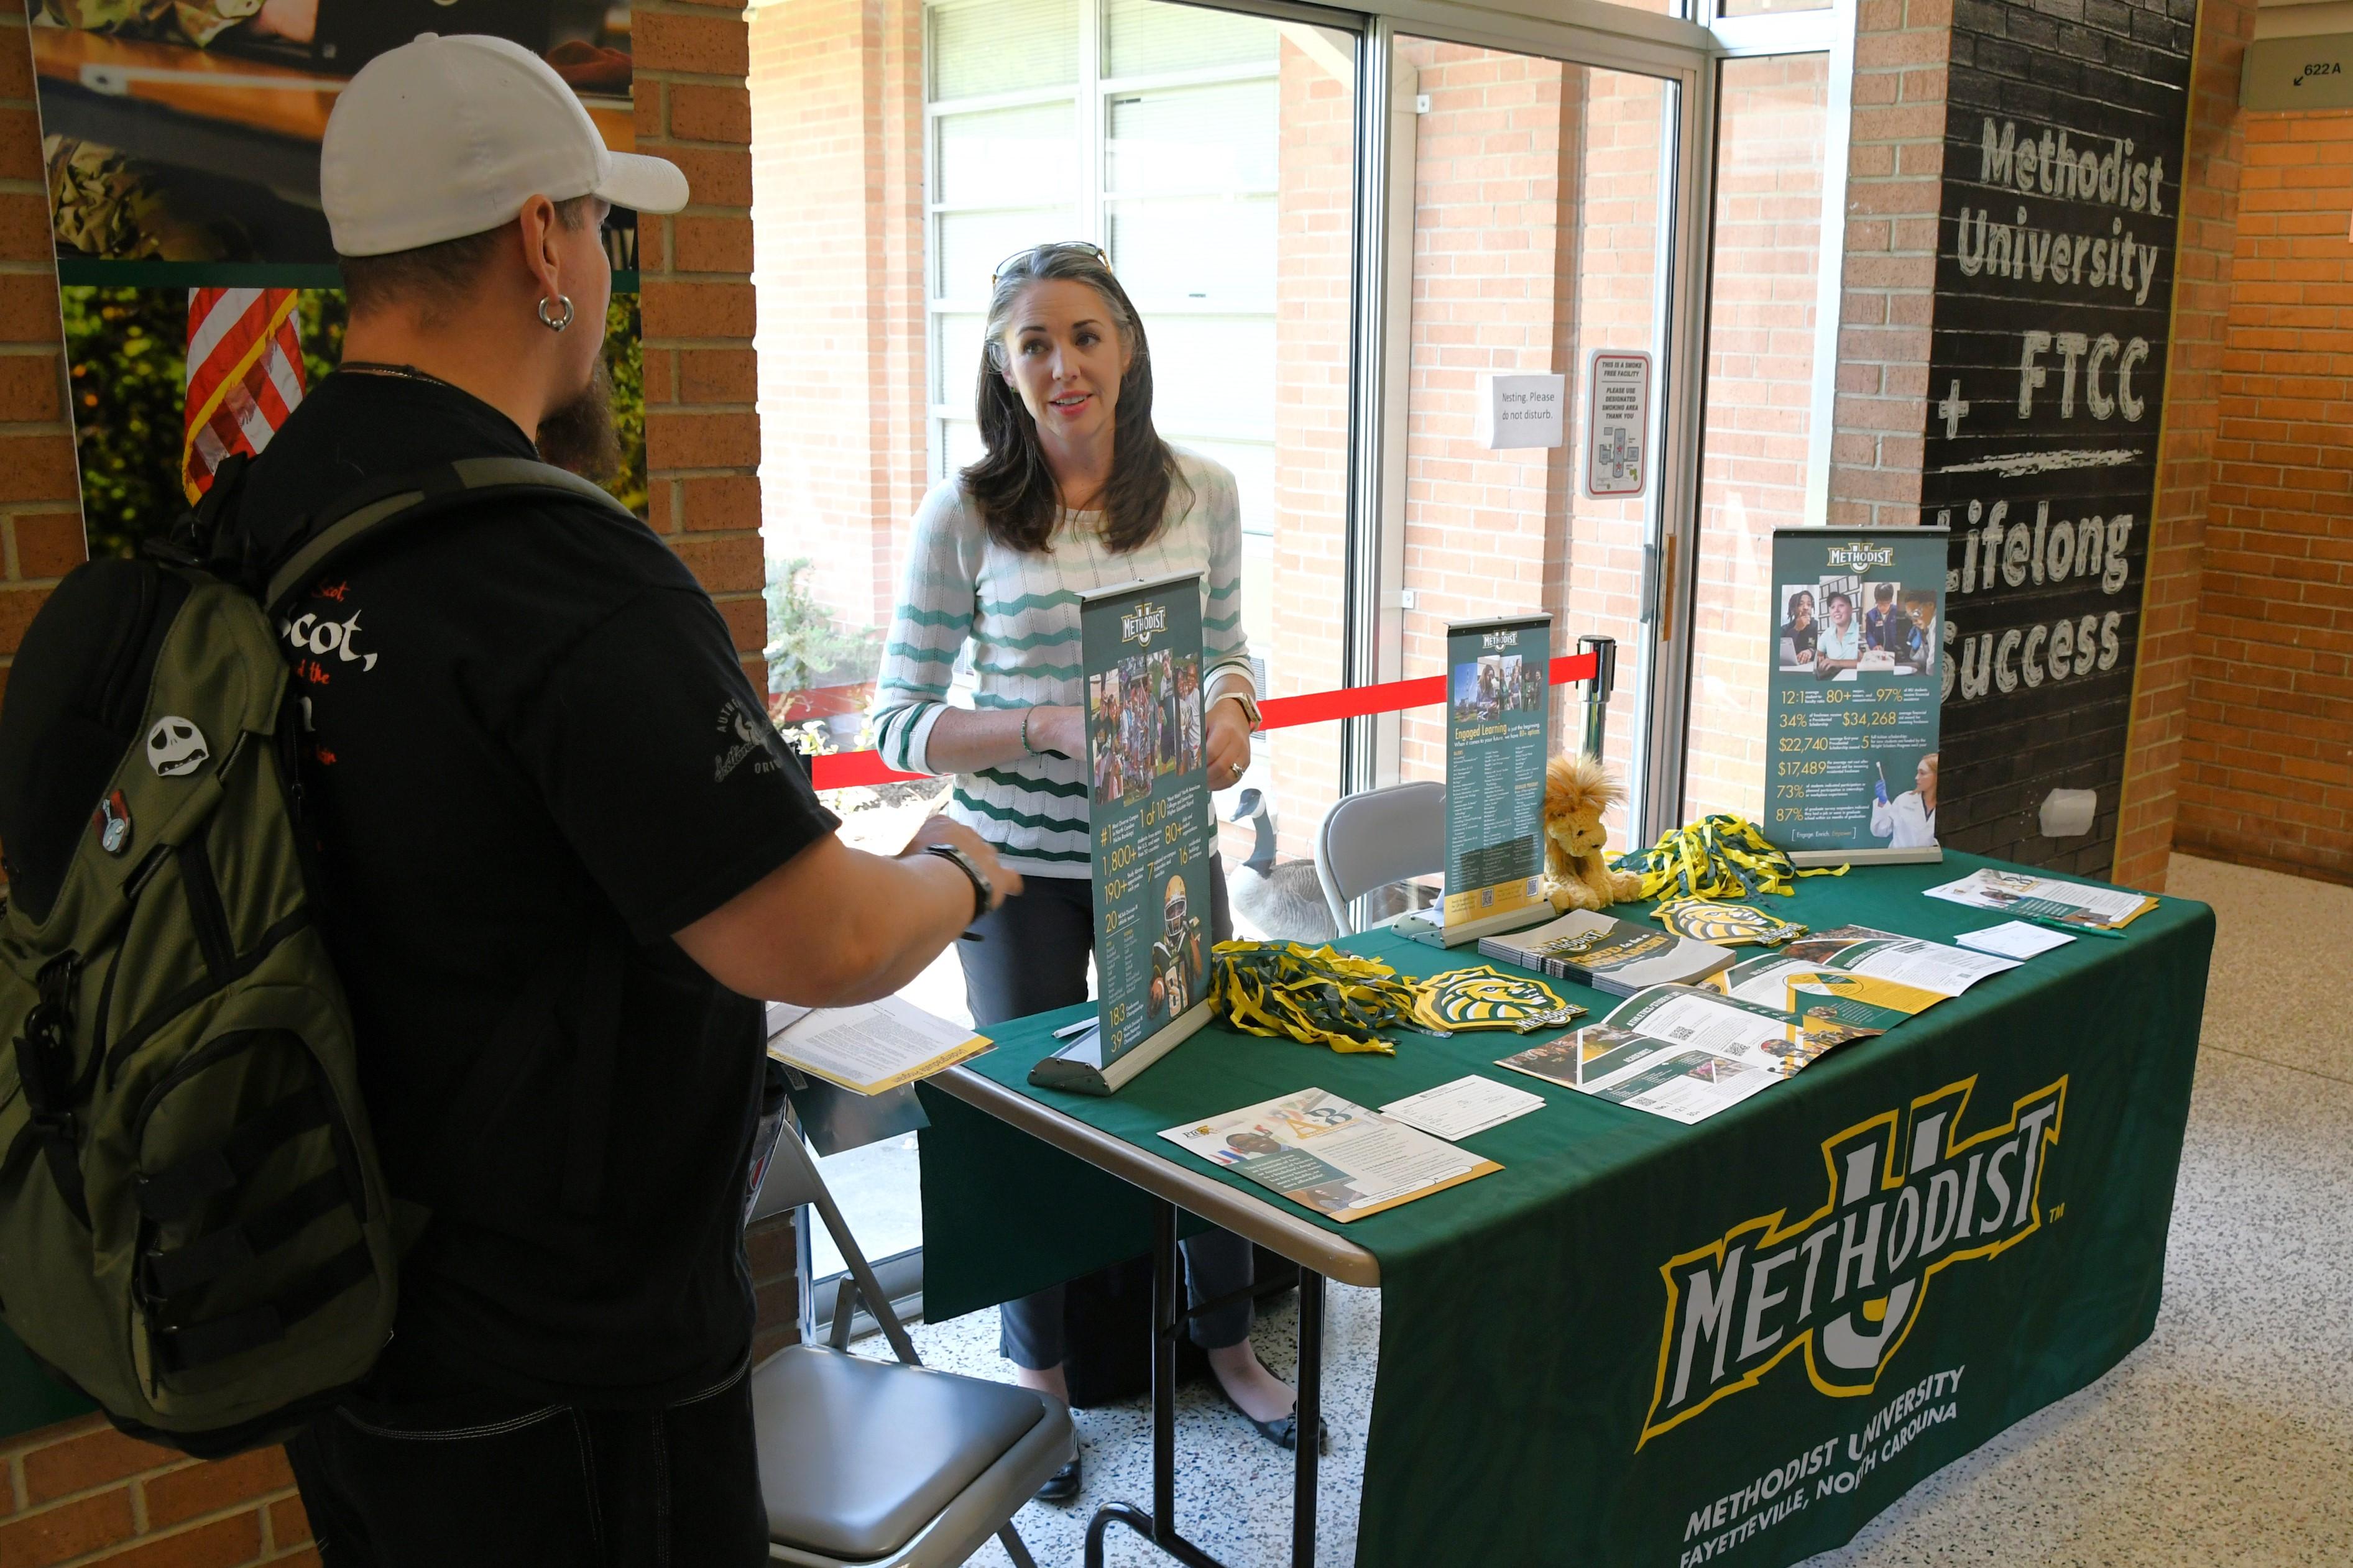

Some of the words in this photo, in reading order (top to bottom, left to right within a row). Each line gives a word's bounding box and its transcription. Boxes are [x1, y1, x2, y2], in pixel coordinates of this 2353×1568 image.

[1980, 117, 2163, 216] Methodist
[1958, 206, 2158, 306] University
[2018, 330, 2150, 422] FTCC
[1529, 392, 1555, 402] Please
[1502, 410, 1509, 420] do
[1510, 411, 1522, 420] not
[1524, 409, 1554, 419] disturb.
[1830, 549, 1891, 565] METHODIST
[1123, 609, 1164, 639] METHODIST
[1484, 633, 1517, 648] METHODIST
[1782, 690, 1805, 704] 12:1
[1826, 689, 1852, 703] 80+
[1876, 689, 1902, 702] 97%
[1780, 714, 1807, 728] 34%
[1842, 712, 1897, 727] $34,268
[1455, 724, 1480, 742] Engaged
[1481, 722, 1507, 735] Learning
[1861, 736, 1869, 749] 5
[1779, 737, 1829, 753] $22,740
[1778, 760, 1827, 777] $17,489
[1777, 785, 1804, 799] 73%
[1146, 802, 1156, 825] of
[1157, 799, 1167, 820] 10
[1776, 807, 1804, 822] 87%
[1101, 824, 1112, 847] #1
[1165, 822, 1182, 845] 80+
[1103, 845, 1136, 878] 1,800+
[1179, 845, 1189, 866] 16
[1147, 862, 1155, 883] 7
[1104, 879, 1127, 905] 190+
[1105, 910, 1118, 933] 20
[1527, 930, 1604, 955] METHODIST
[1563, 946, 1623, 963] PROUD
[1109, 1002, 1126, 1029] 183
[1516, 1004, 1581, 1029] METHODIST
[1110, 1030, 1123, 1053] 39
[2049, 1203, 2066, 1224] TM
[1667, 1101, 2056, 1409] METHODIST
[1683, 1437, 1838, 1543] METHODIST
[1848, 1364, 1966, 1461] UNIVERSITY
[1680, 1487, 1811, 1568] FAYETTEVILLE,
[1881, 1401, 1957, 1462] CAROLINA
